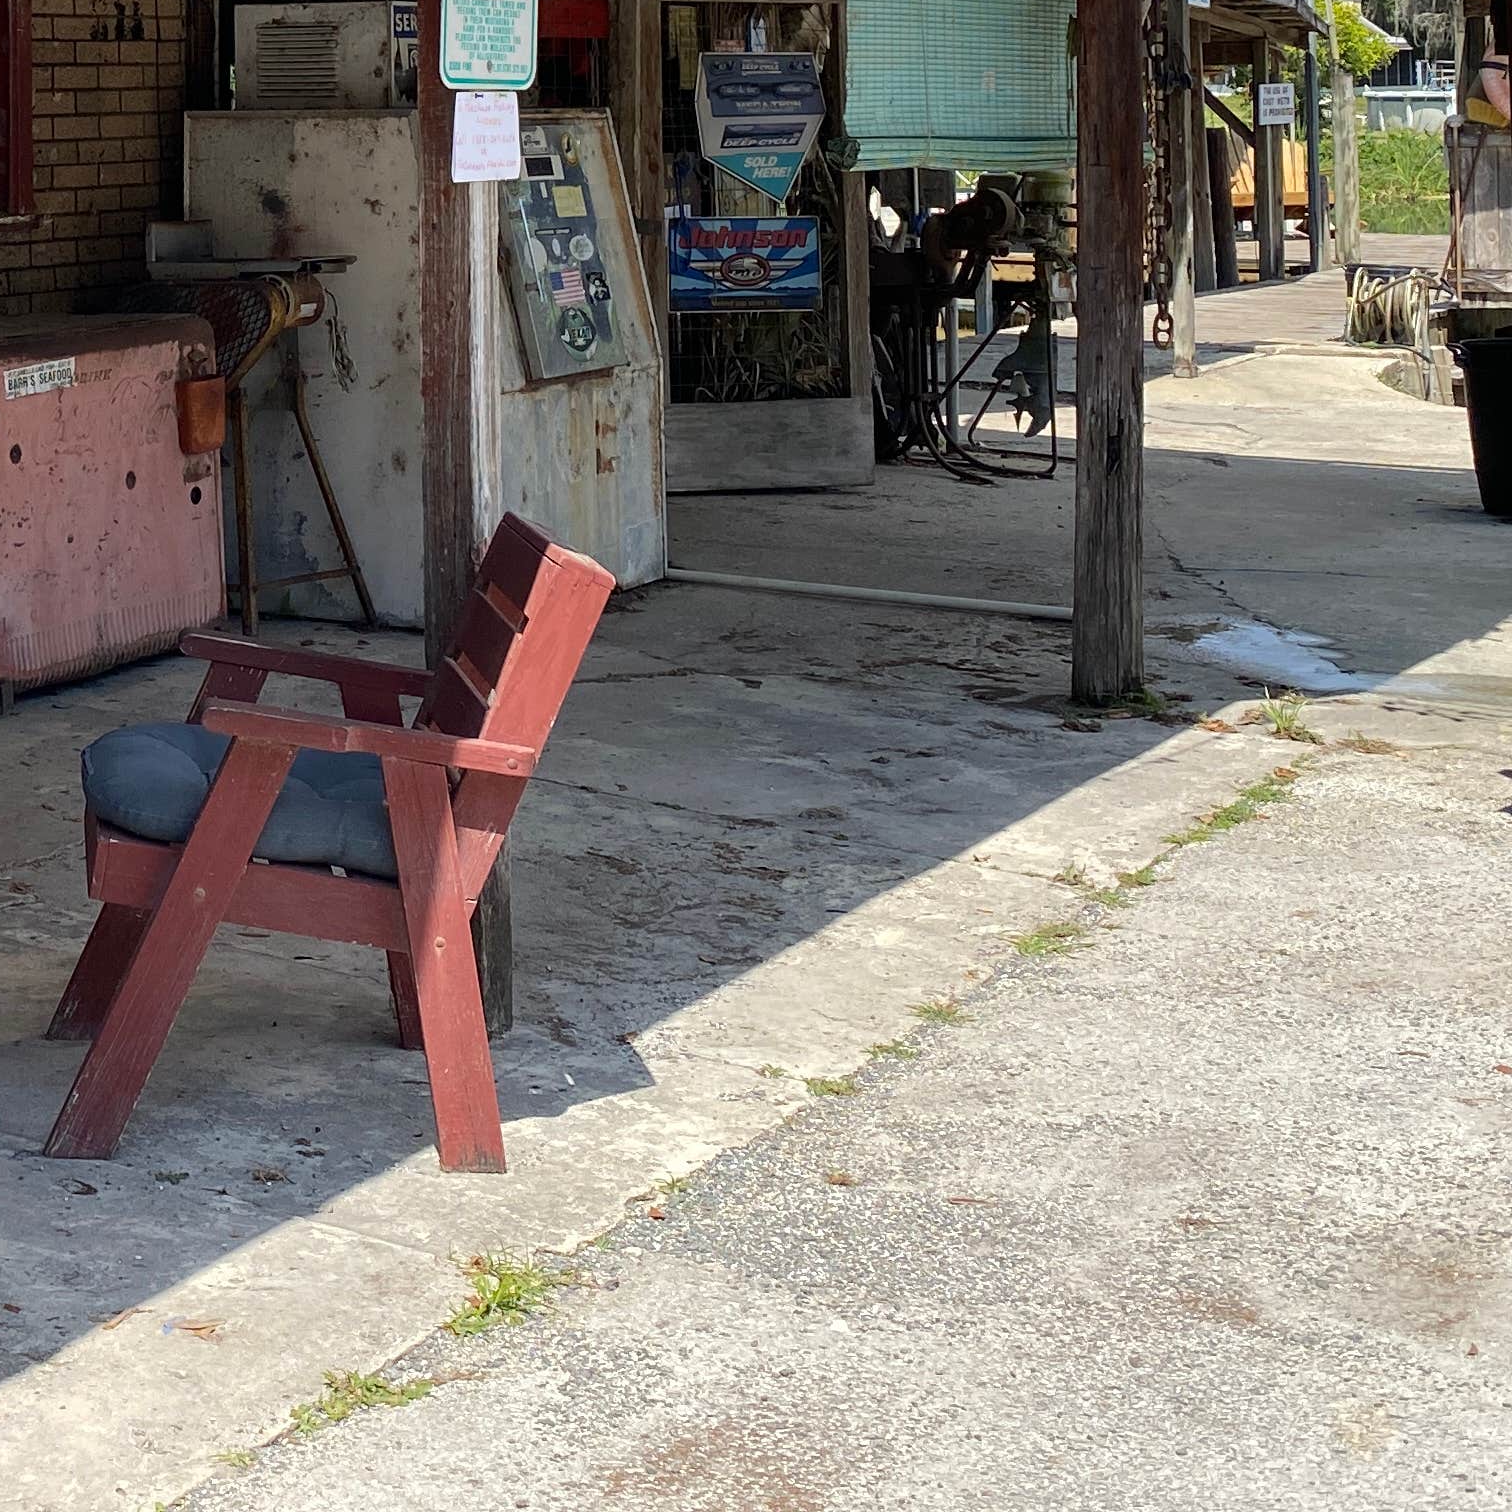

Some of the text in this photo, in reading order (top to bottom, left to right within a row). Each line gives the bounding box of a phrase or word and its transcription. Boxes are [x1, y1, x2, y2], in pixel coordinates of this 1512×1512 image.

[743, 156, 778, 168] SOLD
[752, 167, 792, 179] HERE!
[678, 225, 809, 249] Johnson
[38, 367, 73, 385] SEAFOOD
